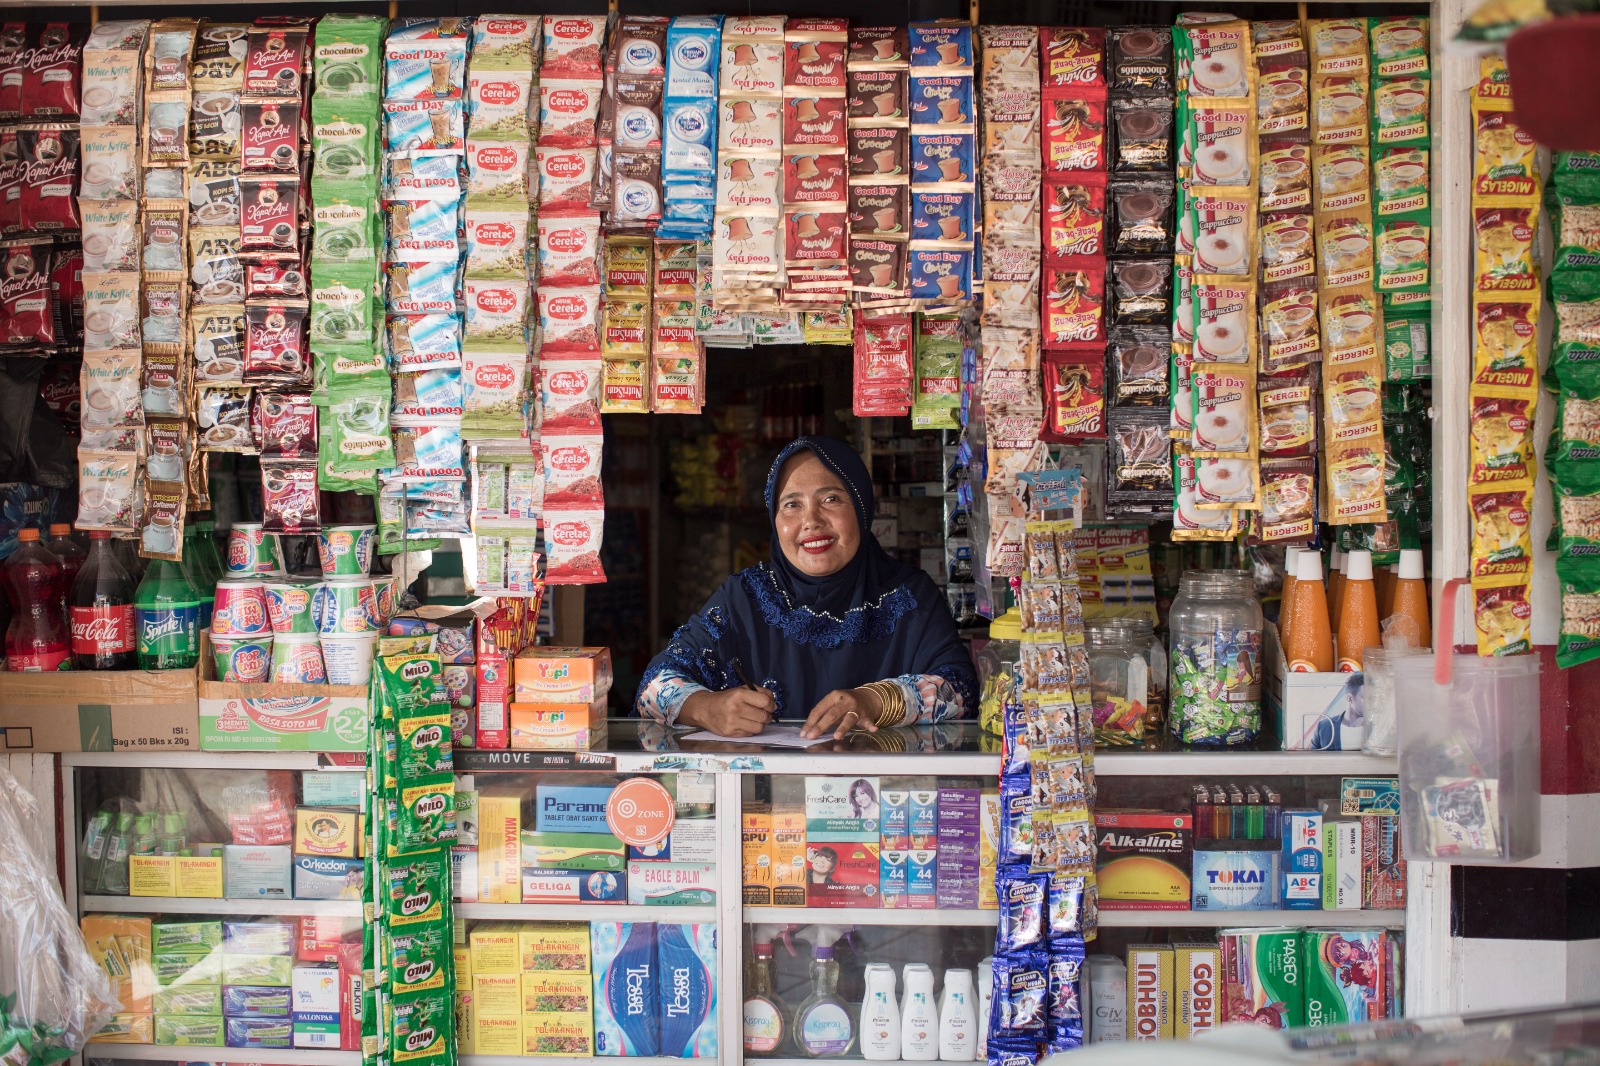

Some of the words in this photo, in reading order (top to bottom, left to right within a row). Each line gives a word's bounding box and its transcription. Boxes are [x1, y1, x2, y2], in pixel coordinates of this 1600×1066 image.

[487, 21, 523, 31] Cerelac
[1194, 43, 1237, 55] Cappuccino
[1257, 40, 1300, 53] ENERGEN
[24, 49, 55, 73] Kapal
[57, 46, 81, 63] Api
[389, 51, 417, 60] Good
[420, 51, 447, 60] Day
[87, 67, 108, 77] White
[1056, 66, 1097, 85] Drink
[480, 88, 516, 98] Cerelac
[387, 103, 415, 112] Good
[418, 101, 445, 111] Day
[1260, 115, 1303, 130] ENERGEN
[1198, 127, 1240, 142] Cappuccino
[86, 142, 107, 152] White
[477, 154, 514, 164] Cerelac
[20, 161, 53, 183] Kapal
[54, 158, 76, 174] Api
[400, 178, 423, 188] Day
[425, 178, 455, 187] Good
[1482, 181, 1531, 193] MIGELAS
[227, 184, 239, 194] SUS
[1264, 193, 1306, 208] ENERGEN
[86, 213, 107, 223] White
[1200, 216, 1241, 229] Cappuccino
[476, 230, 511, 239] Cerelac
[399, 240, 423, 250] Day
[424, 239, 454, 248] Good
[1267, 263, 1310, 279] ENERGEN
[608, 271, 646, 285] NutriSari
[660, 271, 694, 284] NutriSari
[1484, 279, 1531, 290] MIGELAS
[478, 296, 513, 306] Cerelac
[1200, 303, 1242, 318] Cappuccino
[1273, 339, 1316, 356] ENERGEN
[1483, 372, 1529, 384] MIGELAS
[1199, 392, 1241, 406] Cappuccino
[1477, 468, 1525, 480] MIGELAS
[1100, 528, 1134, 537] Gillette
[237, 607, 256, 620] MIE
[244, 615, 262, 631] POP
[146, 621, 179, 640] Sprite
[239, 652, 258, 663] POP
[244, 659, 263, 672] MIE
[405, 666, 430, 676] MILO
[538, 663, 569, 678] Yupi
[258, 716, 277, 727] RASA
[280, 720, 300, 729] SOTO
[537, 710, 565, 723] Yupi
[217, 722, 225, 730] 3
[336, 716, 367, 733] 24
[113, 738, 127, 747] Bag
[138, 738, 148, 746] 50
[150, 737, 165, 745] Bks
[174, 737, 189, 747] 20g
[416, 732, 440, 744] MILO
[489, 753, 530, 764] MOVE
[544, 797, 607, 813] Parame
[807, 796, 847, 804] FreshCare
[418, 801, 443, 813] MILO
[637, 811, 664, 819] ZONE
[890, 811, 904, 821] 44
[919, 811, 933, 821] 44
[1099, 815, 1117, 823] ABC
[743, 833, 766, 842] GPU
[776, 833, 802, 842] GPU
[1307, 819, 1318, 847] ABC
[505, 817, 517, 863] MIXAGRIP
[1099, 831, 1182, 849] Alkaline
[869, 845, 879, 854] HOT
[302, 858, 346, 871] Oskadon
[505, 867, 517, 885] FLU
[645, 870, 672, 883] EAGLE
[676, 870, 700, 884] BALM
[890, 870, 904, 879] 44
[917, 870, 932, 879] 44
[1206, 870, 1265, 884] TOKAI
[530, 882, 571, 891] GELIGA
[1290, 876, 1316, 887] ABC
[404, 896, 428, 908] MILO
[1282, 938, 1297, 984] PASEO
[408, 965, 431, 976] MILO
[626, 964, 650, 1016] Tessa
[667, 967, 690, 1018] Tessa
[353, 980, 361, 1015] PILKITA
[1096, 1006, 1123, 1020] Giv
[1309, 999, 1322, 1030] SEO
[814, 1020, 841, 1029] Kispray
[409, 1031, 433, 1043] MILO
